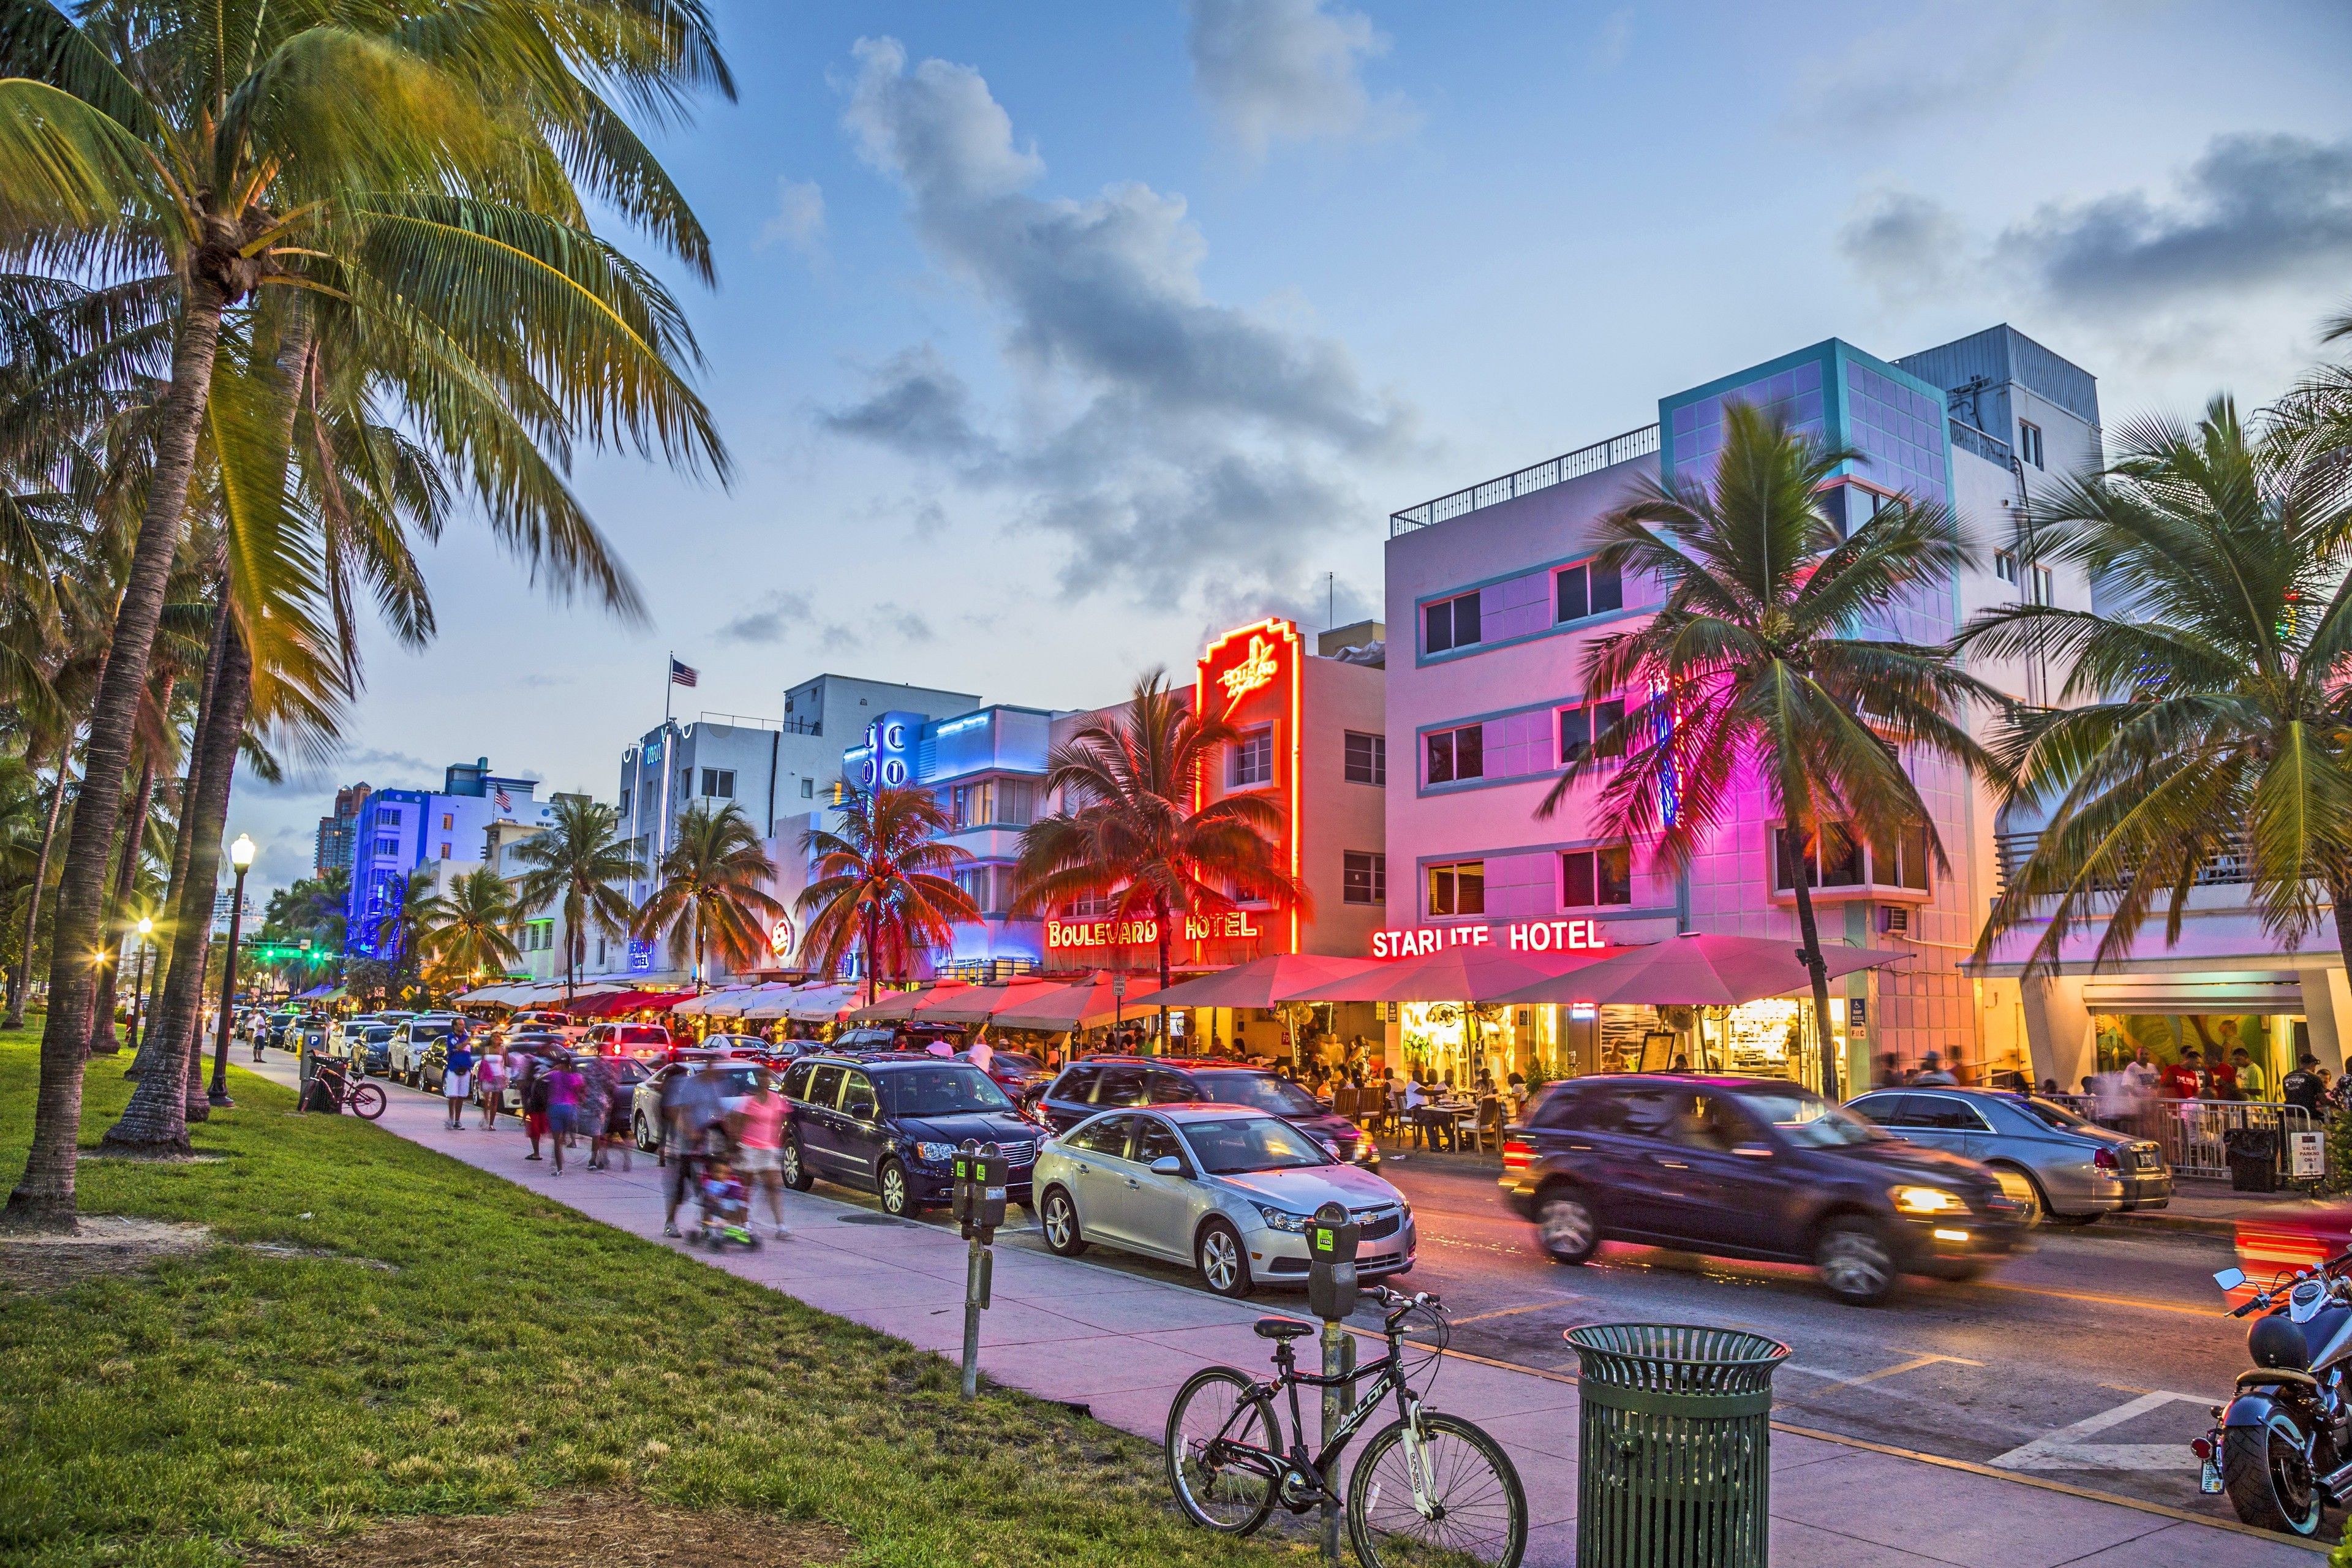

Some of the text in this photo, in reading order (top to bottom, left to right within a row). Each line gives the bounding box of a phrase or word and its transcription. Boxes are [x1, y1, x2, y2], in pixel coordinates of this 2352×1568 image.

[1048, 911, 1257, 948] BOULEVARD HOTEL
[1510, 920, 1606, 951] HOTEL
[311, 1036, 318, 1044] P
[1334, 1378, 1391, 1434] AVALON
[1231, 1446, 1256, 1455] AVALON
